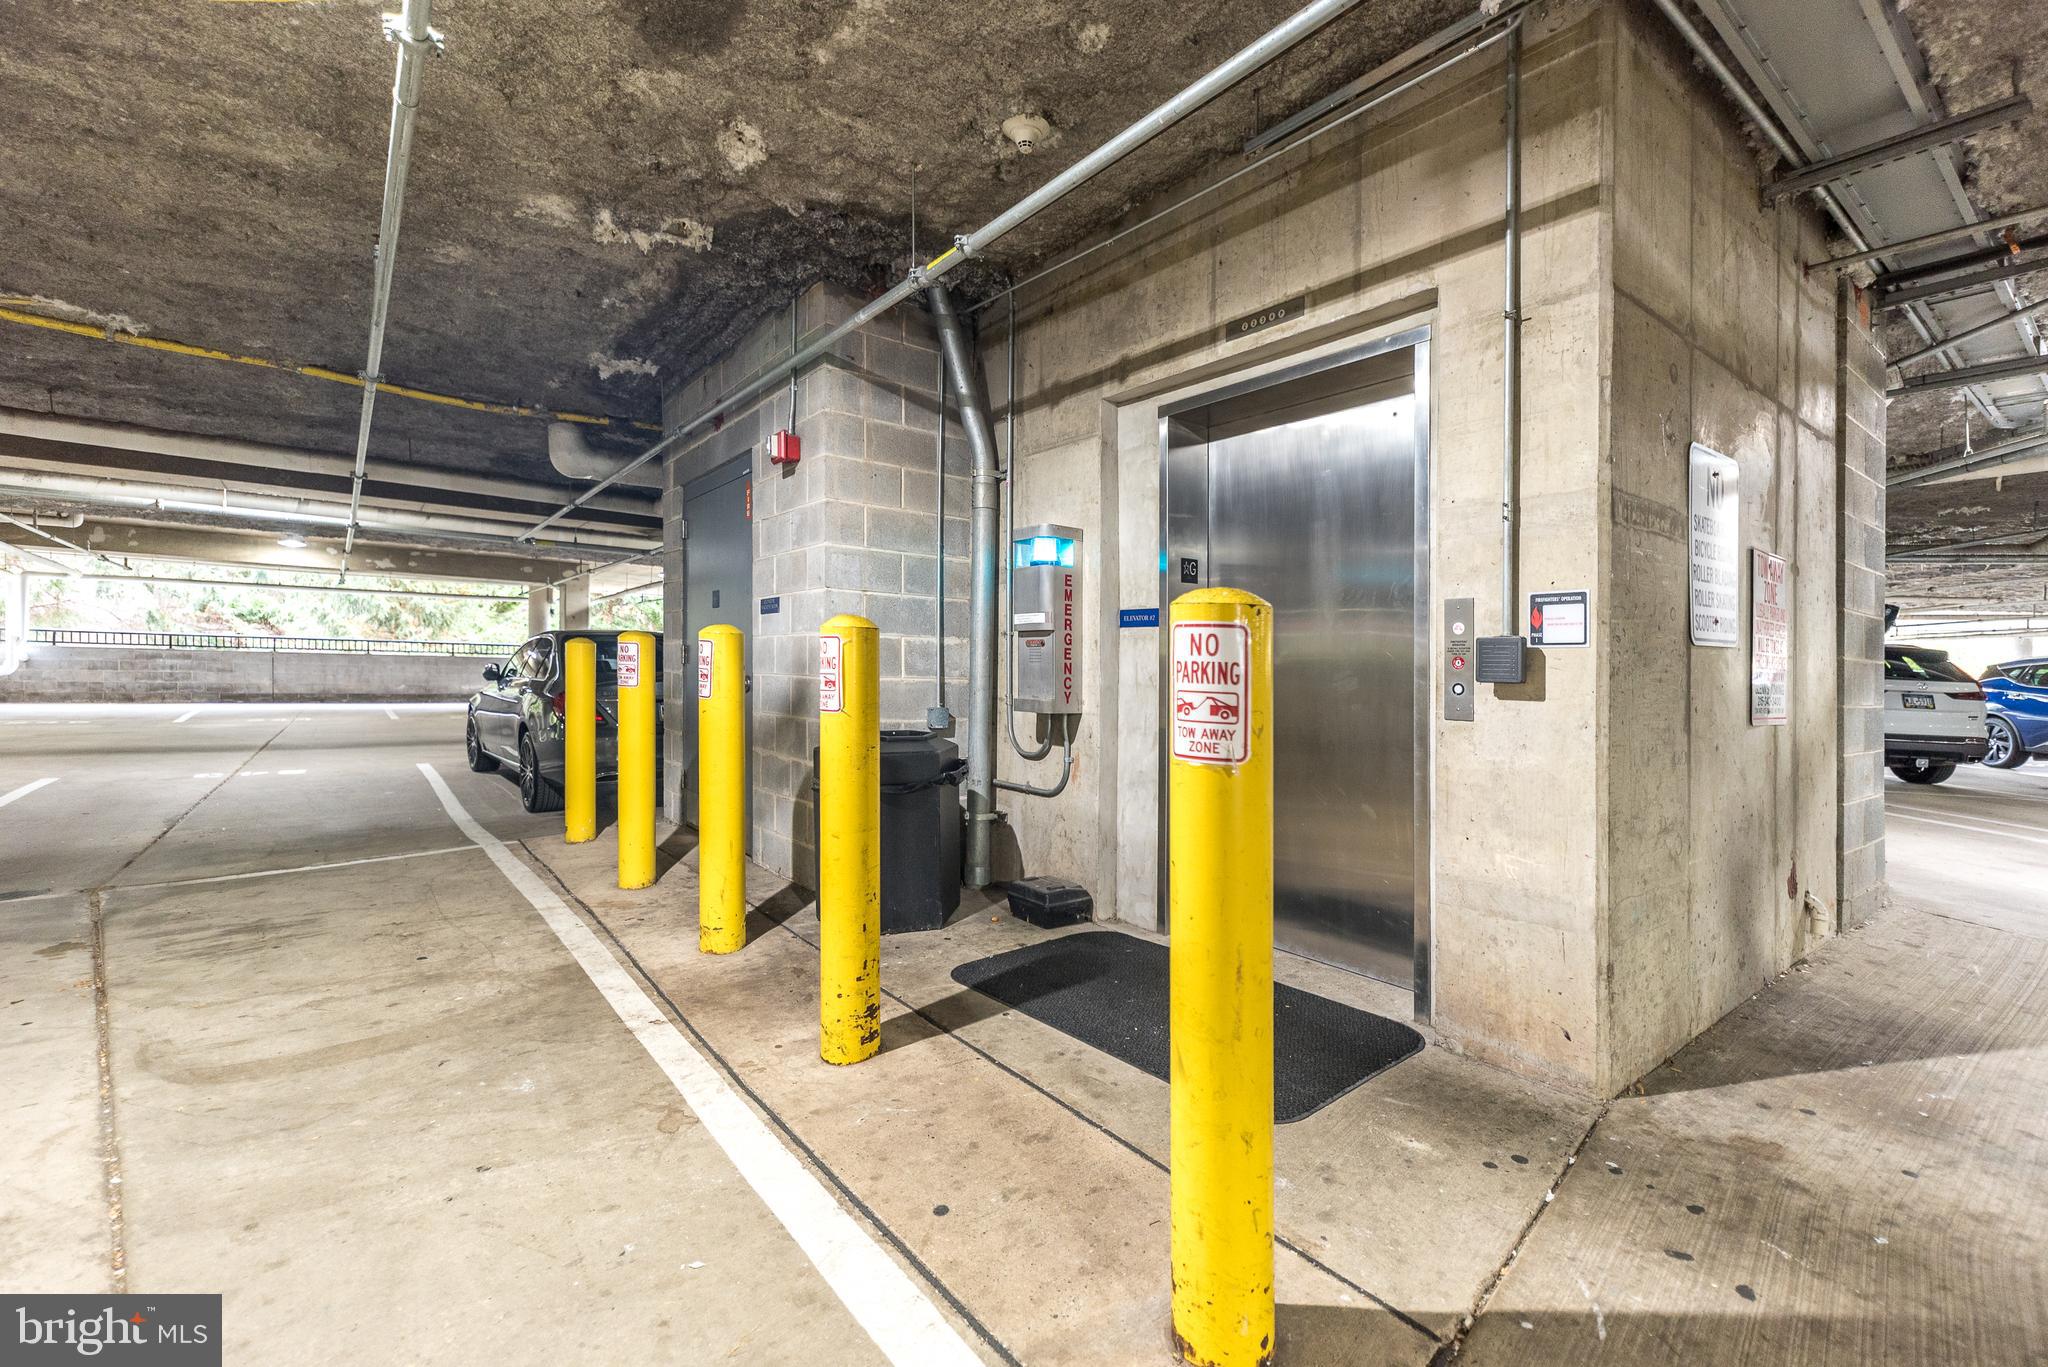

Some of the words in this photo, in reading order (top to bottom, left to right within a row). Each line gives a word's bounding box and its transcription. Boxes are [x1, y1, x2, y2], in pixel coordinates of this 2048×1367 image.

[1707, 466, 1724, 510] NO
[1693, 563, 1714, 583] ROLLER
[1695, 588, 1715, 608] ROLLER
[620, 645, 629, 653] NO
[1064, 574, 1073, 704] EMERGENCY
[1190, 633, 1219, 657] NO
[1176, 661, 1240, 686] PARKING
[1178, 726, 1196, 738] TOW
[1201, 728, 1236, 741] AWAY
[1189, 741, 1220, 754] ZONE
